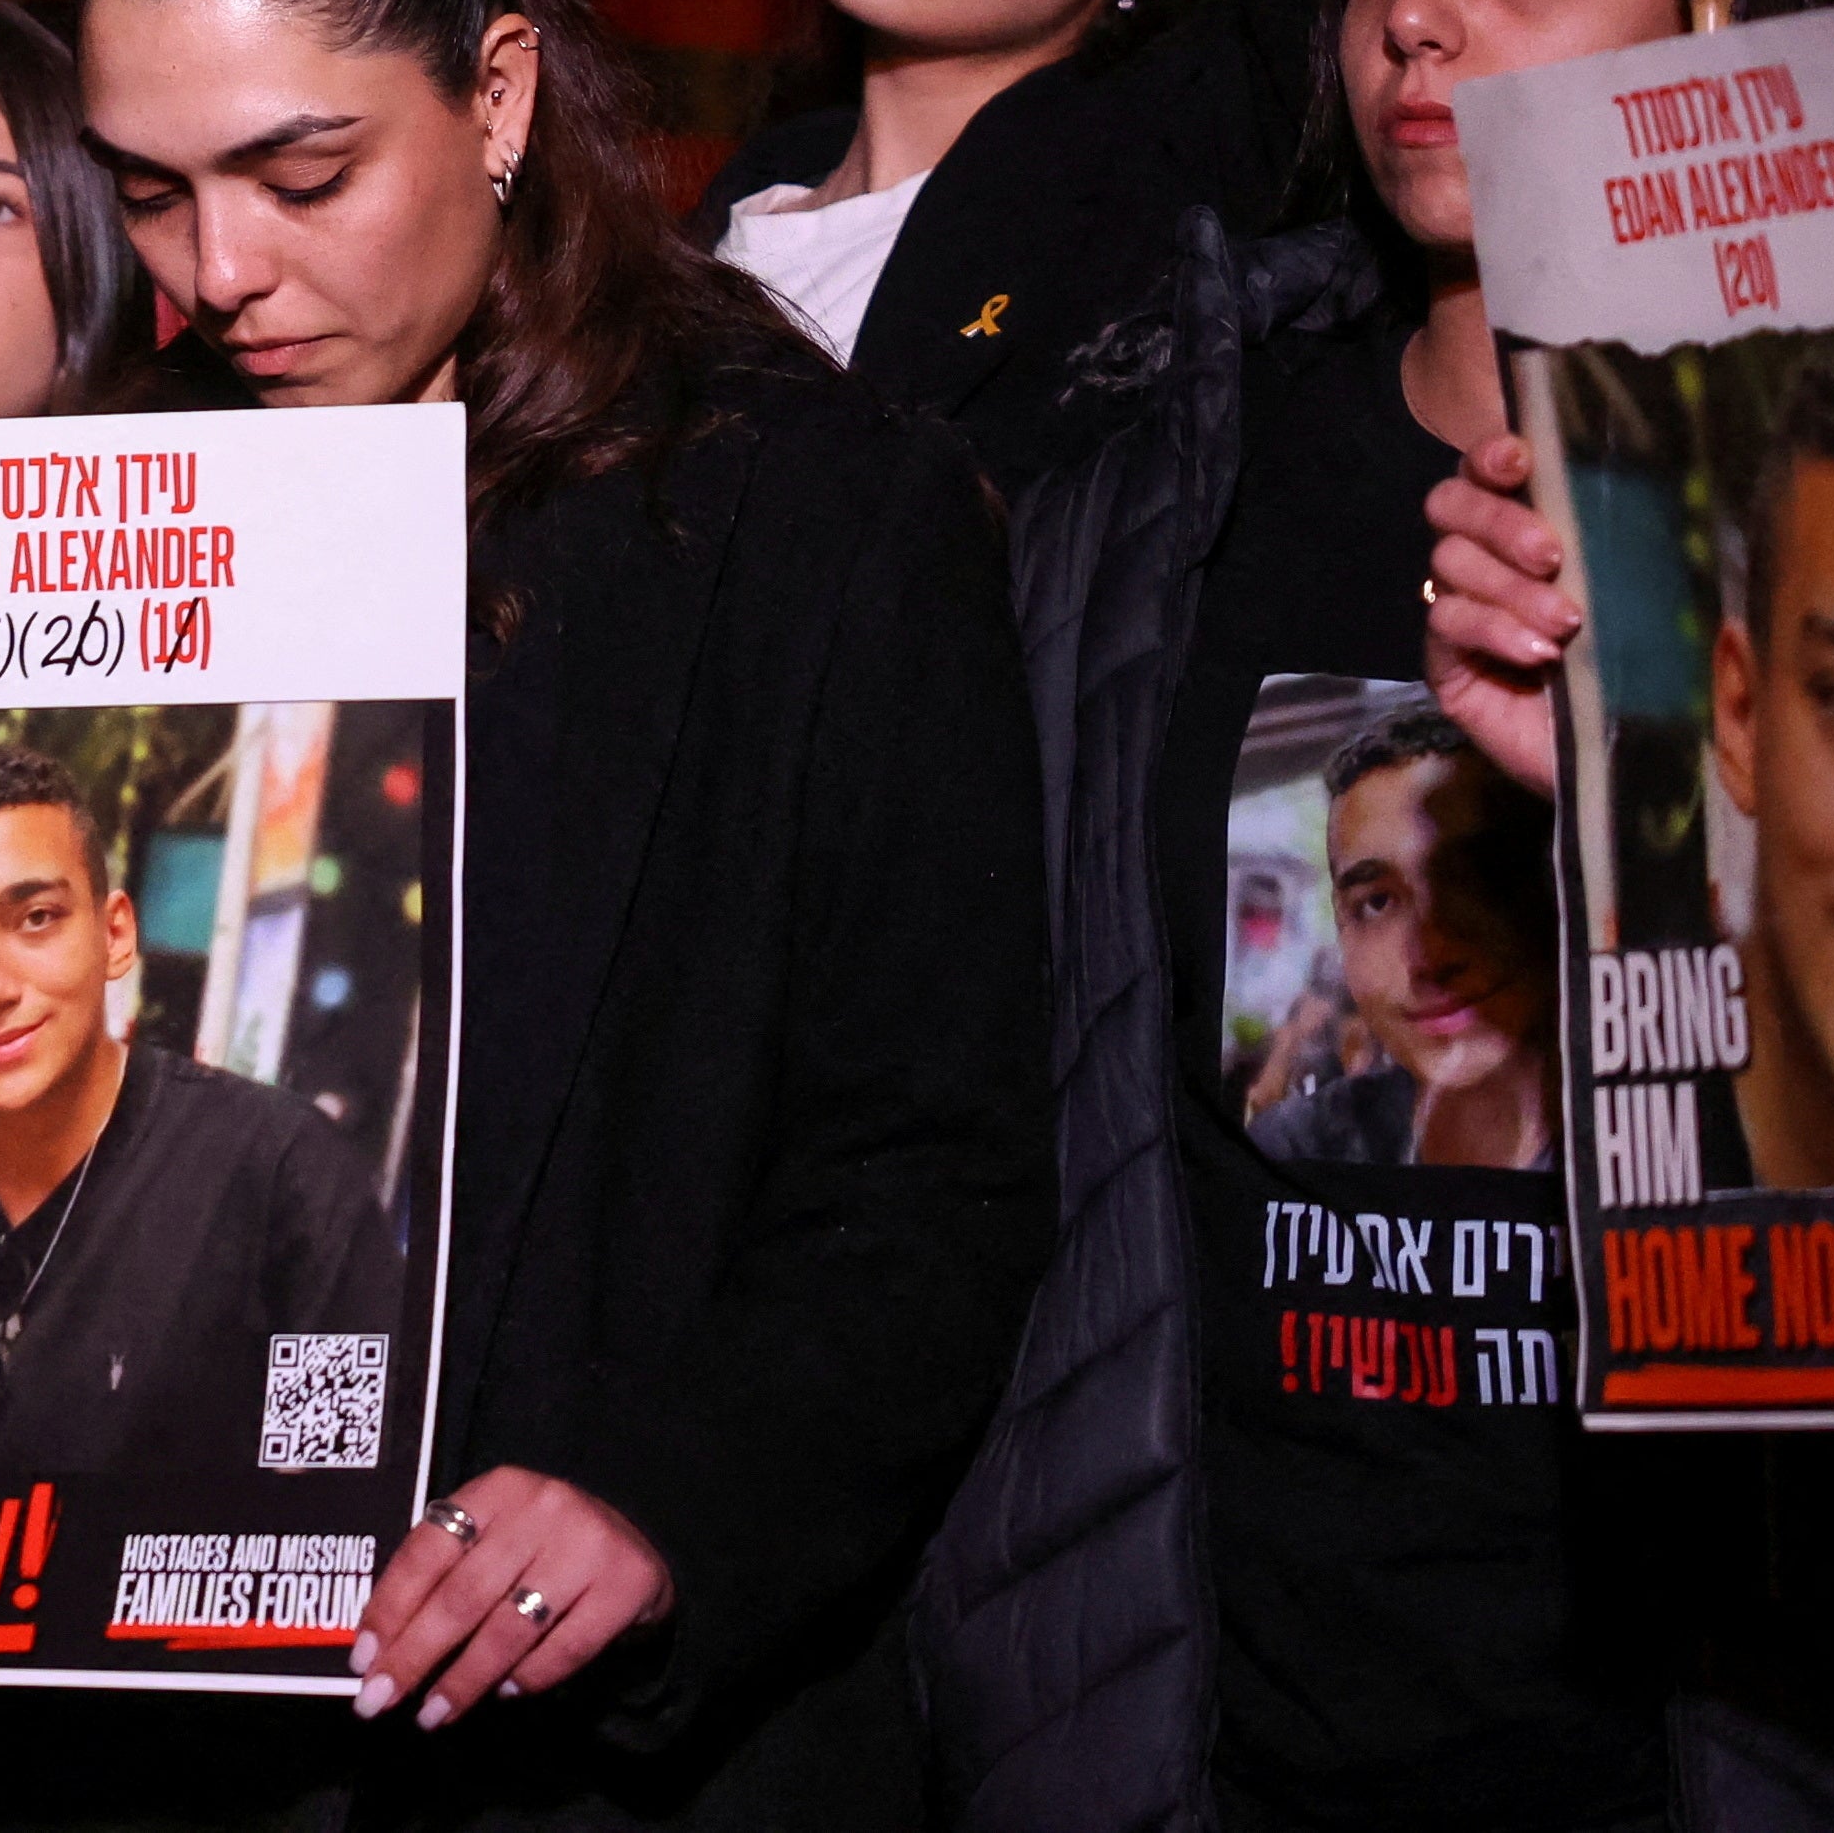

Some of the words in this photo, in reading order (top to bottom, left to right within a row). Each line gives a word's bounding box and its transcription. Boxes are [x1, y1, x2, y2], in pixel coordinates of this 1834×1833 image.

[1604, 167, 1686, 245] EDAN
[117, 452, 196, 524] עידן
[10, 526, 235, 594] ALEXANDER
[1590, 944, 1748, 1075] BRING
[1594, 1081, 1702, 1208] HIM
[1355, 1212, 1433, 1295] את
[1603, 1224, 1760, 1352] HOME
[1280, 1309, 1458, 1408] עכשיו!
[121, 1534, 231, 1572] HOSTAGES
[230, 1534, 277, 1572] AND
[277, 1534, 376, 1573] MISSING
[111, 1572, 254, 1627] FAMILIES
[255, 1572, 373, 1631] FORUM
